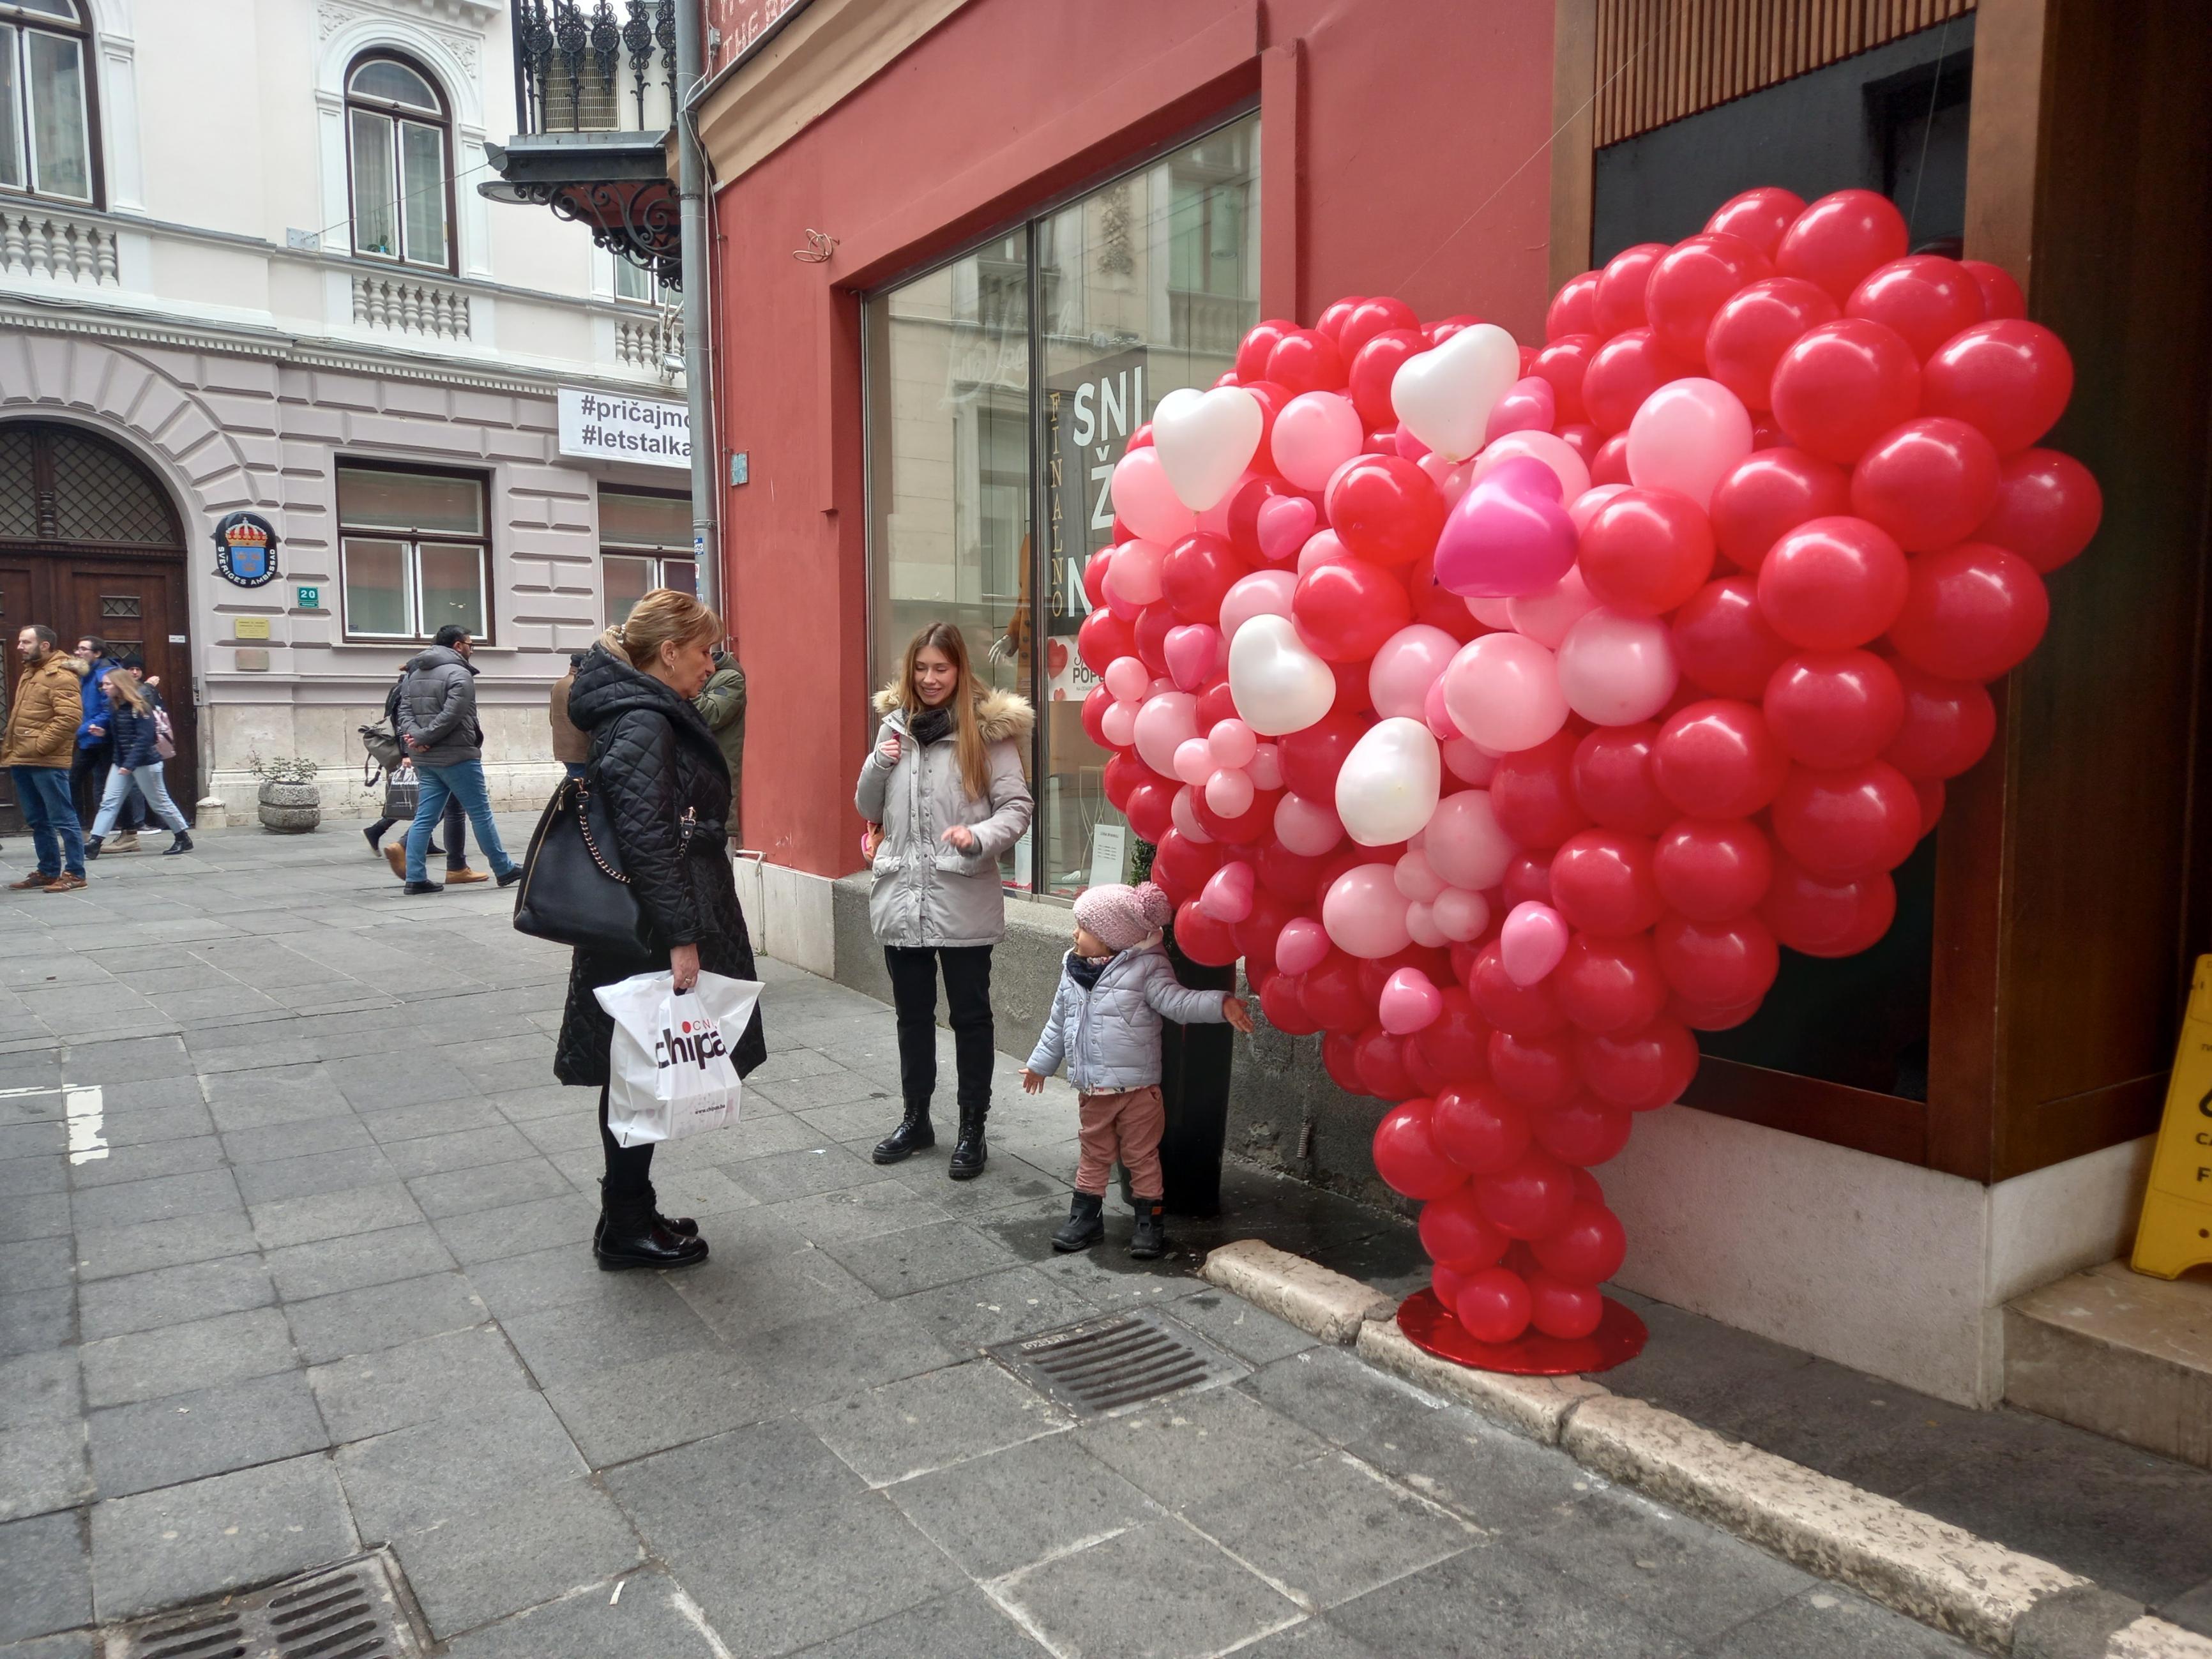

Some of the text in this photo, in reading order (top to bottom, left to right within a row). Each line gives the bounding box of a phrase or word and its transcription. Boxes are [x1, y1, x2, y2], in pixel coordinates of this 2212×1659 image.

[1073, 366, 1142, 446] SNI
[582, 424, 692, 457] #letstalka
[1050, 392, 1064, 618] FINALNO
[218, 546, 275, 585] SVERIGES AMBASSAD
[300, 590, 315, 598] 20
[1073, 667, 1105, 683] POP
